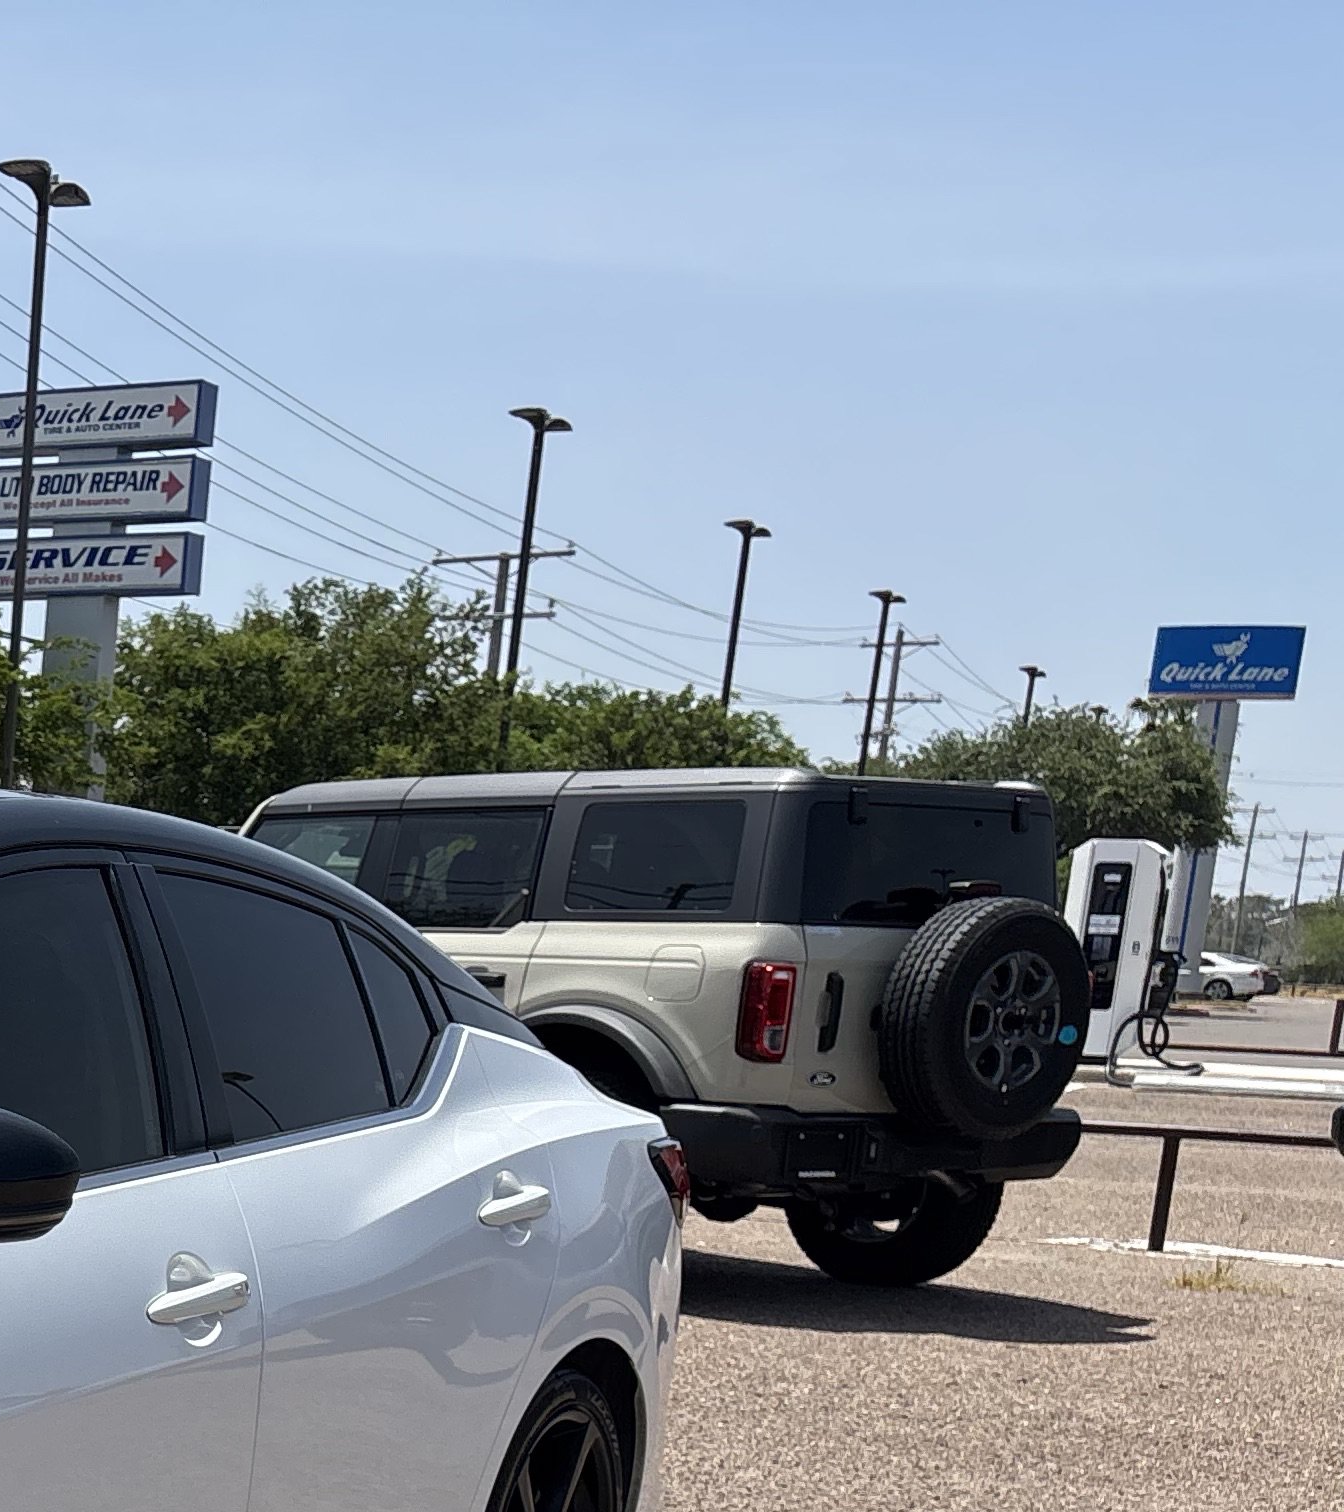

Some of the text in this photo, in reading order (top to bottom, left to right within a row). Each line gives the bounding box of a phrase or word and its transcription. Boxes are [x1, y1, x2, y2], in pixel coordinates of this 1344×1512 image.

[98, 400, 165, 421] Lane
[43, 422, 141, 435] TIRE & AUTO CENTER
[37, 472, 89, 496] BODY
[89, 470, 161, 493] REPAIR
[3, 497, 131, 511] We ccept All Insurance
[25, 574, 60, 585] ervice
[63, 572, 79, 584] All
[82, 572, 123, 583] Makes
[1159, 661, 1289, 683] Quick Lane
